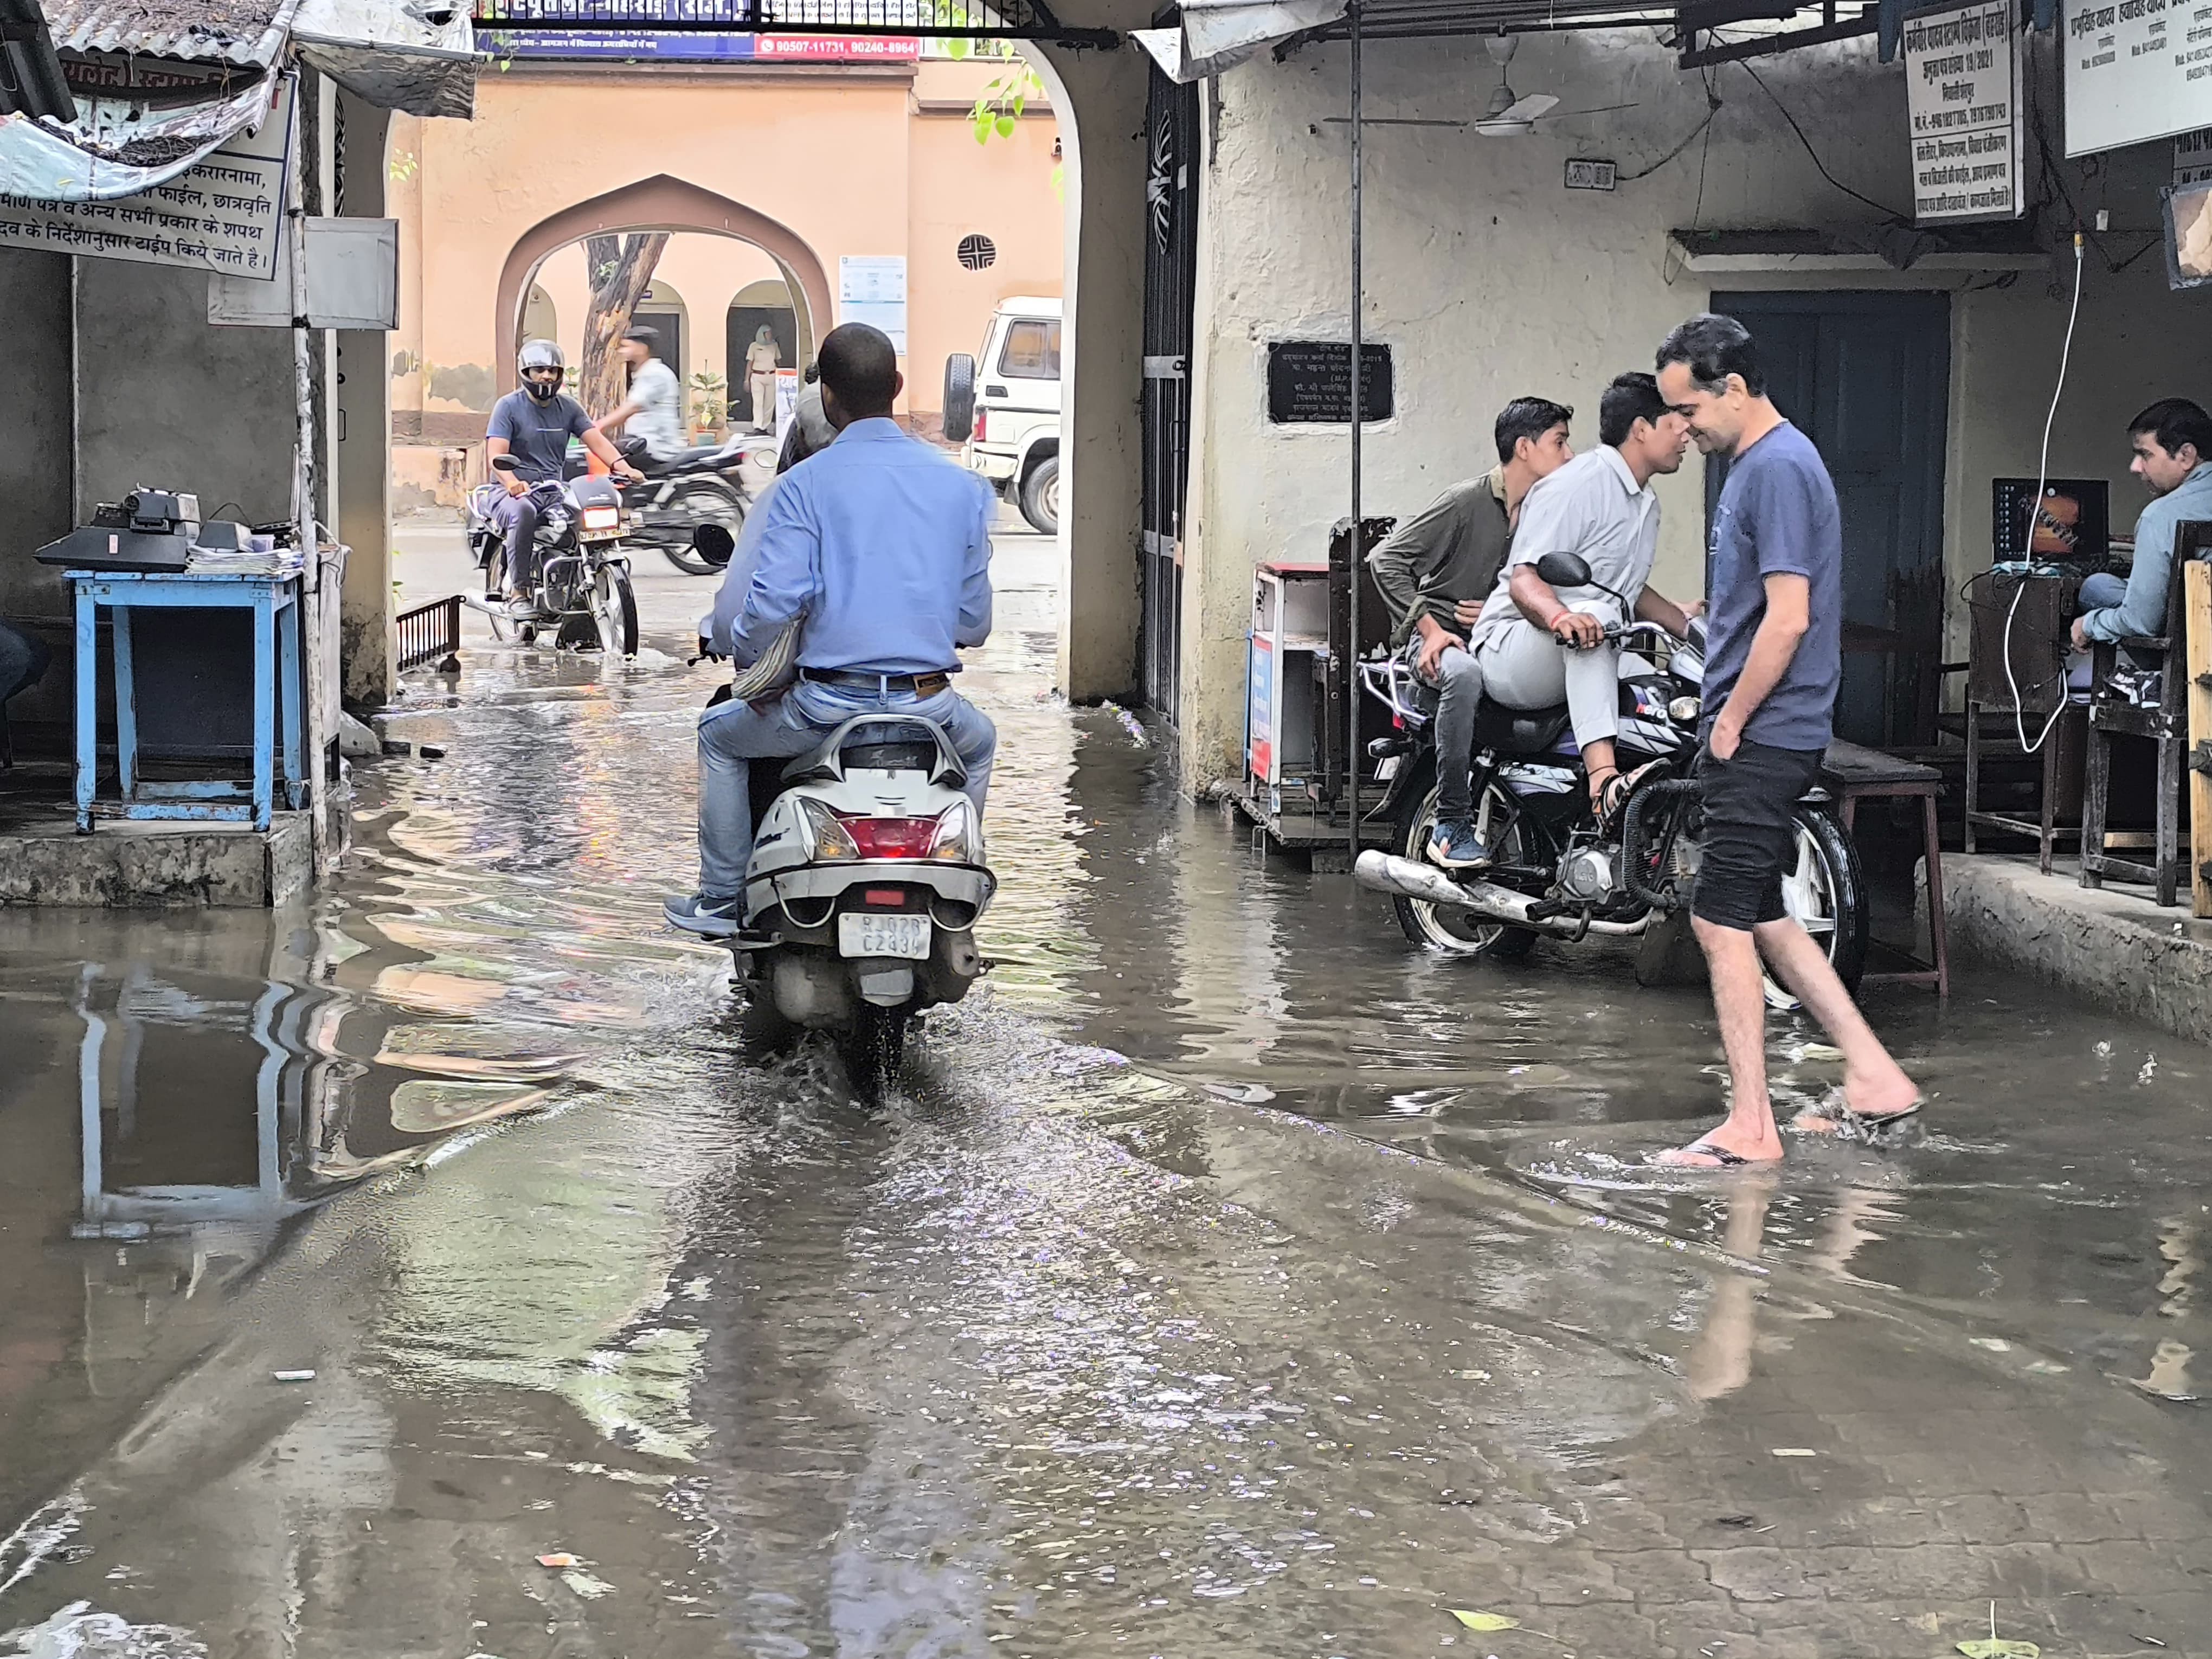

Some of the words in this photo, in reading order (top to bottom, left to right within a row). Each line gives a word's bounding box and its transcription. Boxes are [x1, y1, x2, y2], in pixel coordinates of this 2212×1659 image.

[157, 183, 207, 208] फाईल,
[213, 192, 272, 218] छात्रवृति
[63, 201, 76, 215] व
[80, 202, 114, 221] अन्य
[120, 205, 155, 226] सभी
[159, 213, 198, 232] प्रकार
[203, 214, 218, 234] के
[223, 223, 263, 240] शपथ
[23, 217, 42, 237] के
[46, 221, 133, 251] निर्देशानुसार
[134, 234, 171, 257] टाईप
[175, 237, 207, 260] किये
[213, 244, 245, 266] जाते
